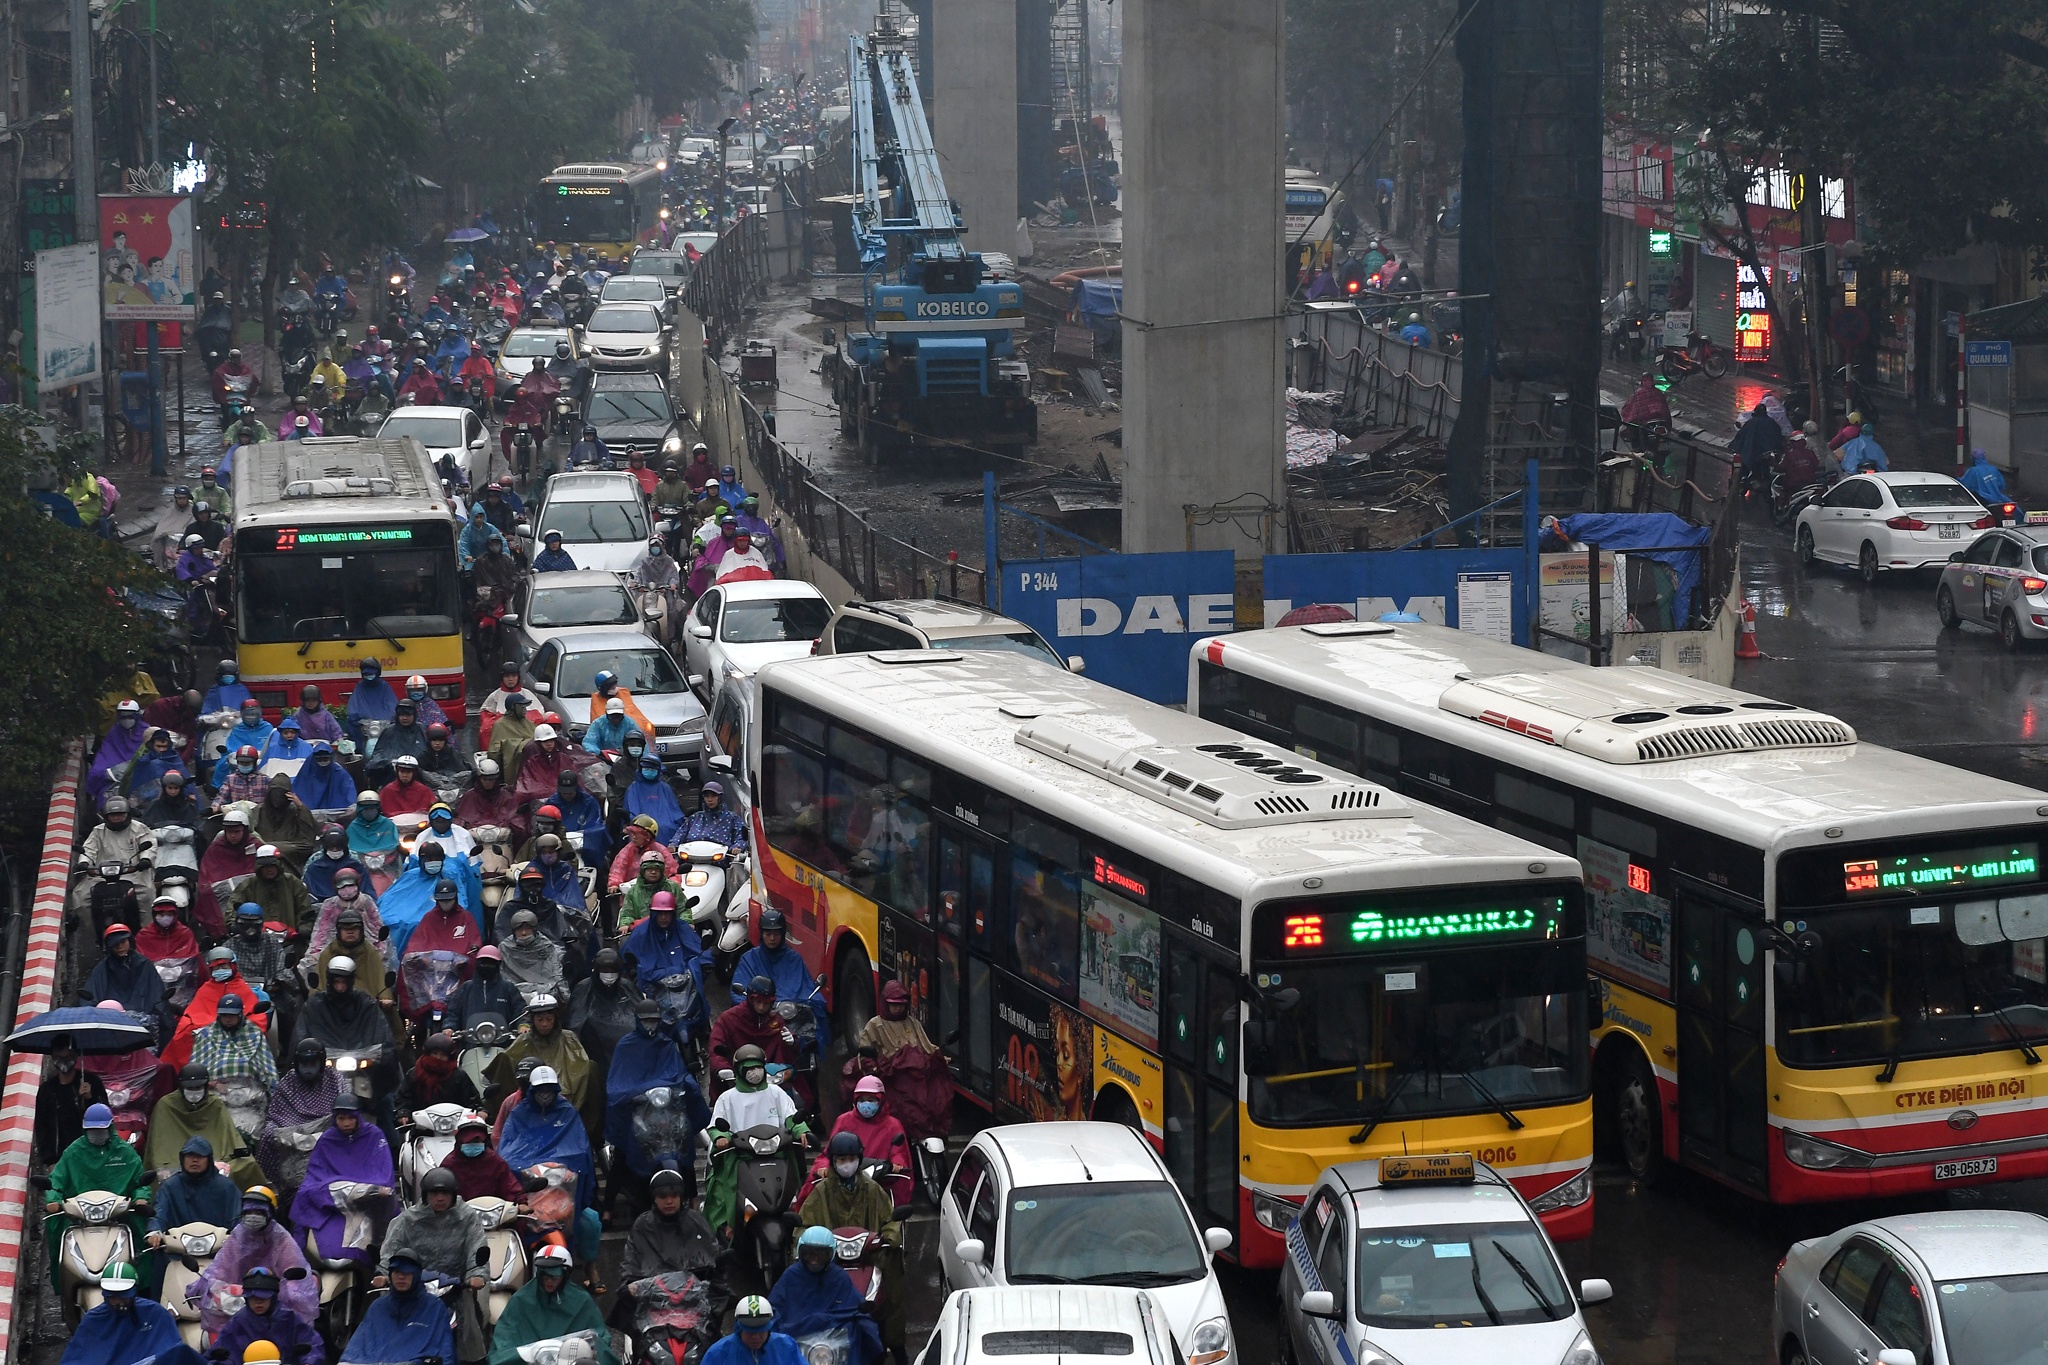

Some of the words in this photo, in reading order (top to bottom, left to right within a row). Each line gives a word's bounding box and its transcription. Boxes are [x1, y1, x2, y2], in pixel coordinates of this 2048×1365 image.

[917, 301, 990, 317] KOBELCO
[1970, 354, 1990, 364] QUAN
[1992, 354, 2008, 364] HOA
[1021, 572, 1030, 592] P
[1034, 572, 1058, 592] 344
[305, 660, 318, 670] CT
[322, 659, 334, 669] XE
[1603, 1003, 1652, 1037] HANOIBUS
[1101, 1052, 1142, 1087] HANOIBUS
[1895, 1091, 1916, 1108] CT
[1917, 1089, 1935, 1107] XE
[1939, 1084, 1973, 1106] ĐIỆN
[1976, 1080, 1995, 1100] HÀ
[1998, 1077, 2025, 1100] NỘI
[1427, 1158, 1450, 1166] TAXI
[1477, 1145, 1517, 1165] LONG
[1411, 1168, 1447, 1178] THANH
[1450, 1167, 1472, 1177] NGA
[1936, 1158, 1996, 1179] 29B-058.73
